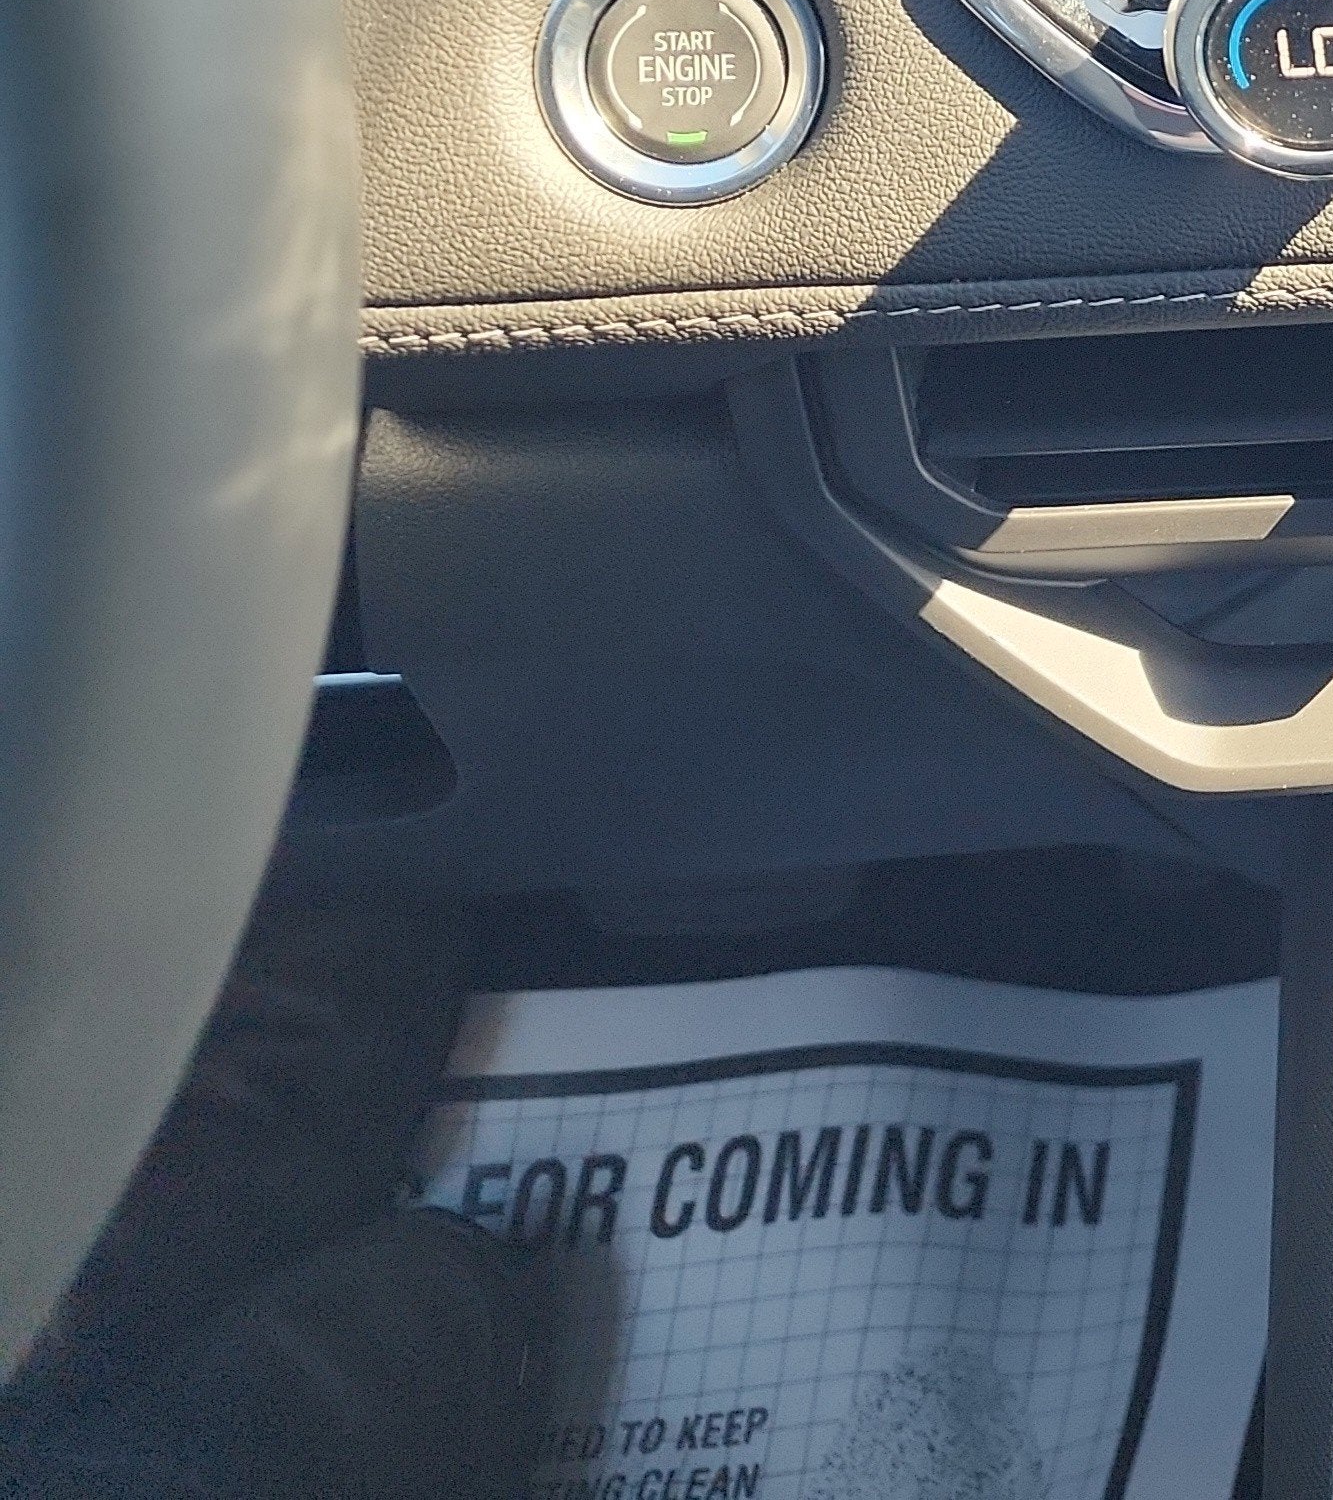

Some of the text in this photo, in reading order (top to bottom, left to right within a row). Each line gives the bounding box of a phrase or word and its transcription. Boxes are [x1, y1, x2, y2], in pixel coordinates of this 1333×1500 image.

[654, 30, 716, 52] START
[638, 54, 737, 83] ENGINE
[661, 86, 713, 107] STOP
[462, 1124, 1110, 1245] FOR COMING IN
[621, 1416, 667, 1457] TO
[675, 1406, 769, 1451] KEEP
[637, 1461, 762, 1500] CLEAN
